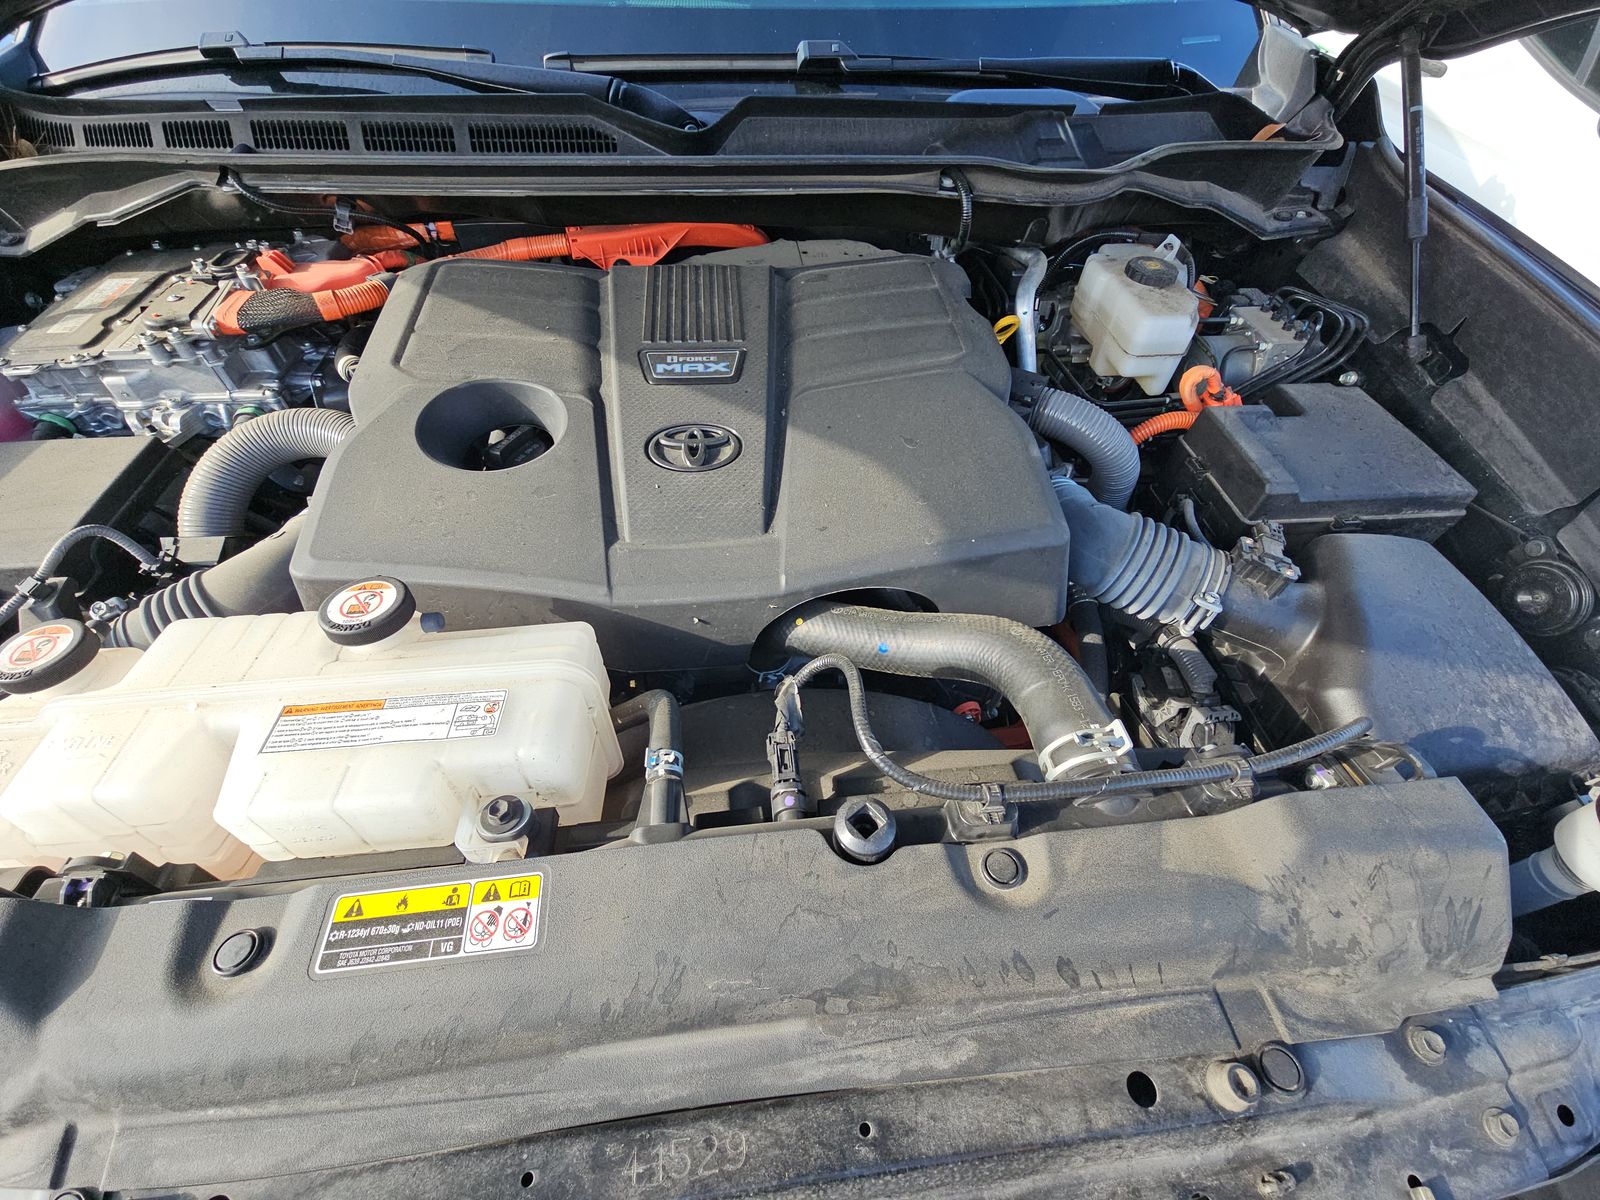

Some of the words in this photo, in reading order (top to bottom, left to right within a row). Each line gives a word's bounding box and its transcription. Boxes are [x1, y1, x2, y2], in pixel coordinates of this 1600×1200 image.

[656, 362, 730, 373] MAX
[339, 927, 370, 939] R-1234yf
[370, 924, 401, 936] 670±30g
[445, 917, 463, 929] (POE)
[339, 950, 359, 960] TOYOTA
[359, 948, 378, 958] MOTOR
[378, 944, 414, 955] CORPORATION
[441, 941, 454, 953] VG
[336, 959, 348, 967] SAE
[621, 1131, 746, 1186] 41529
